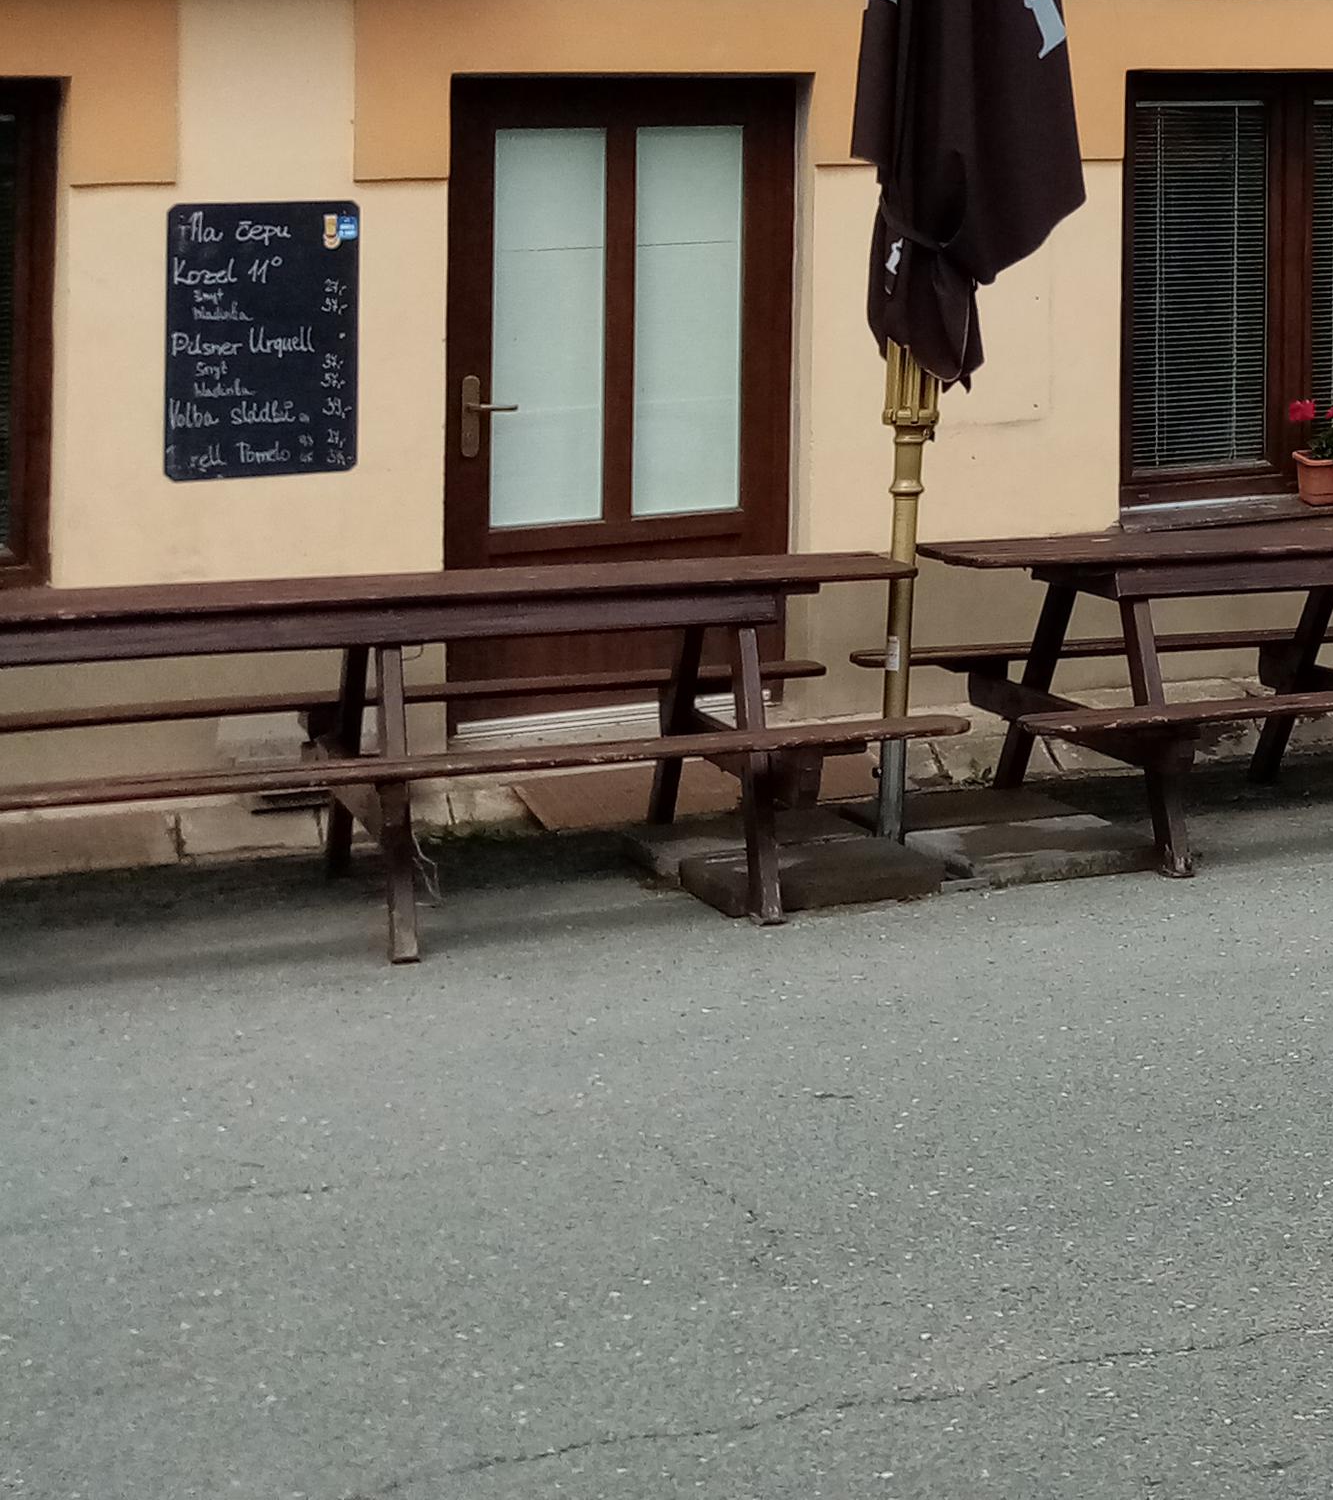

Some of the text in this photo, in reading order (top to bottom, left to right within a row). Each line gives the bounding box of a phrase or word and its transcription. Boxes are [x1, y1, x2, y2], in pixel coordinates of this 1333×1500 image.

[235, 220, 292, 246] čepu
[173, 257, 238, 286] Kozel
[170, 326, 315, 358] Pilsner Urquell
[169, 398, 219, 430] Volba
